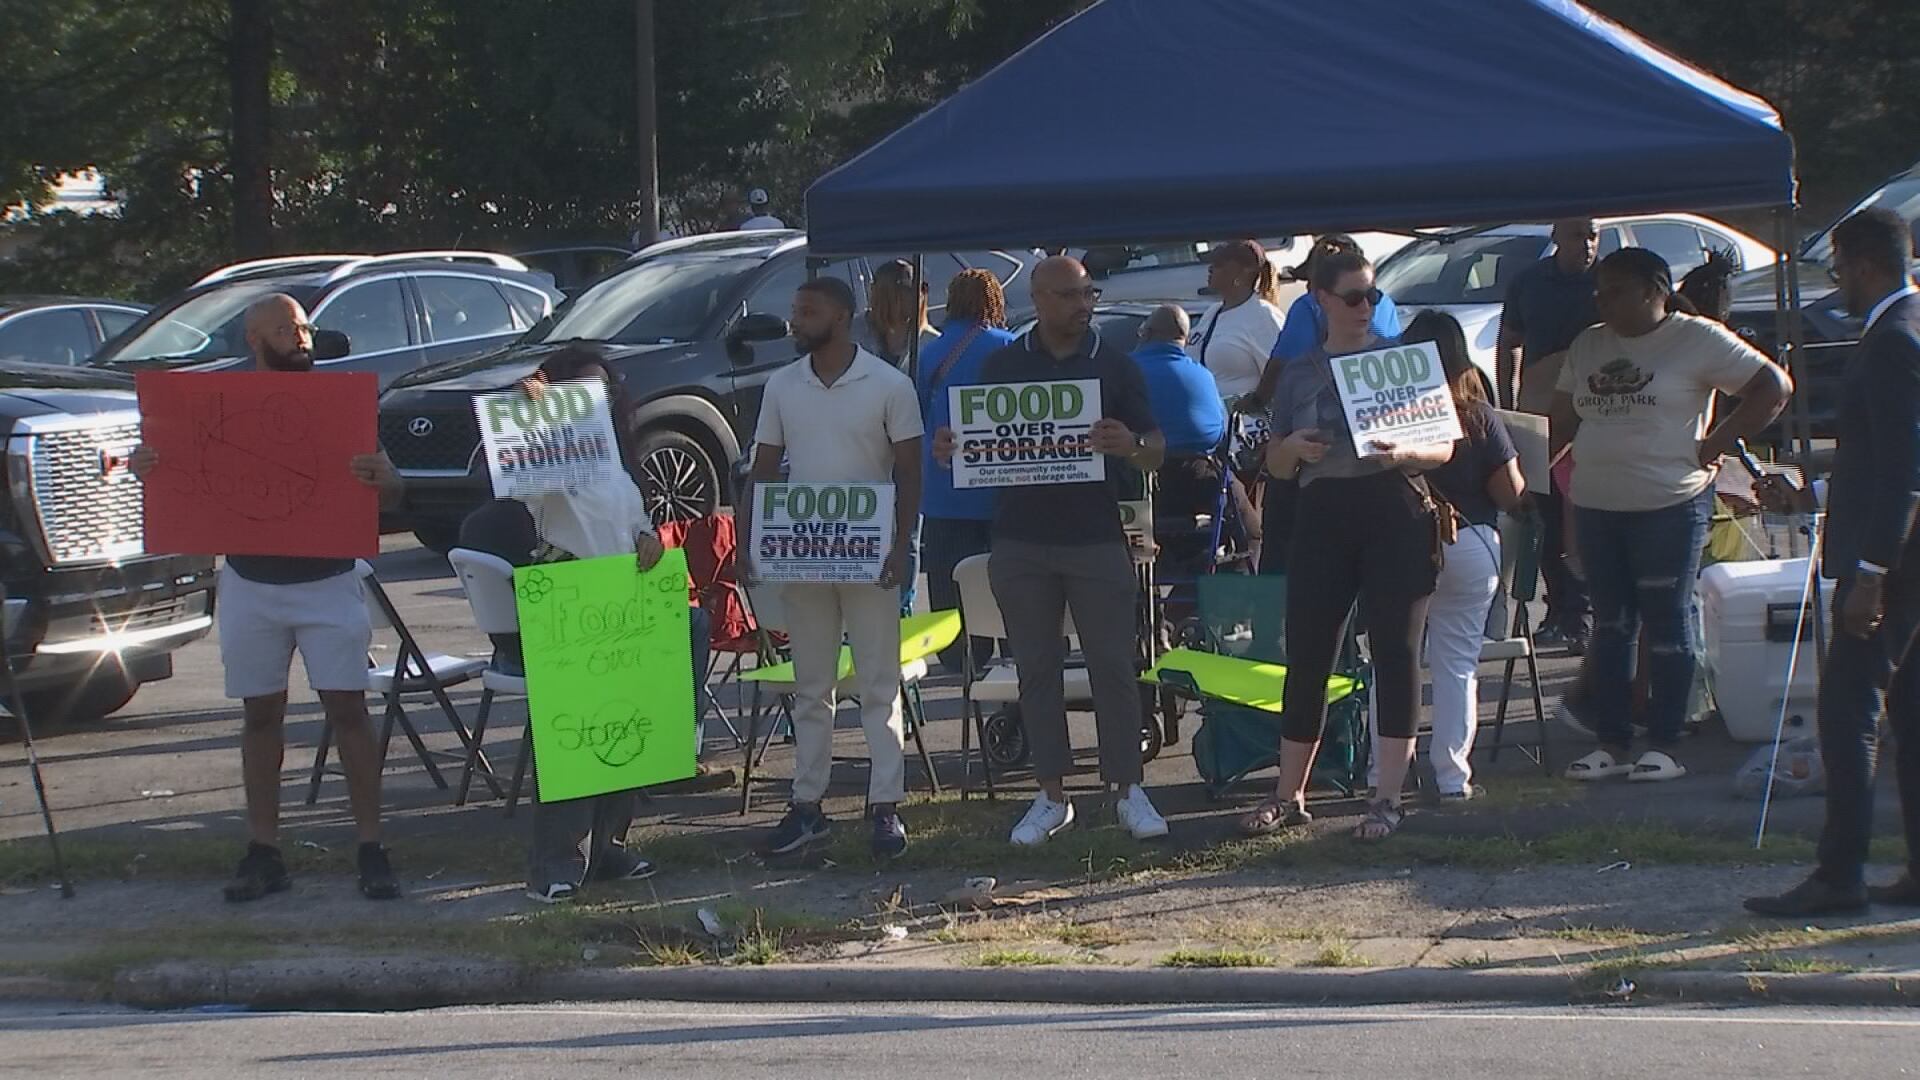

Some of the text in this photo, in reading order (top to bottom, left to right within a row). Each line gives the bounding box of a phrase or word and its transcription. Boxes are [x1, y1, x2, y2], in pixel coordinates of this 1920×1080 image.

[1340, 347, 1430, 395] FOOD
[484, 384, 594, 432] FOOD
[959, 383, 1084, 425] FOOD
[1375, 385, 1417, 404] OVER
[1620, 393, 1658, 406] PARK
[1355, 394, 1449, 431] STORAGE
[995, 421, 1056, 437] OVER
[962, 433, 1093, 464] STORAGE
[979, 463, 1077, 476] Our community needs
[1033, 472, 1065, 482] storage
[763, 485, 878, 522] FOOD
[791, 522, 849, 537] OVER
[759, 535, 881, 559] STORAGE
[550, 571, 645, 643] Food
[551, 713, 654, 752] Storage
